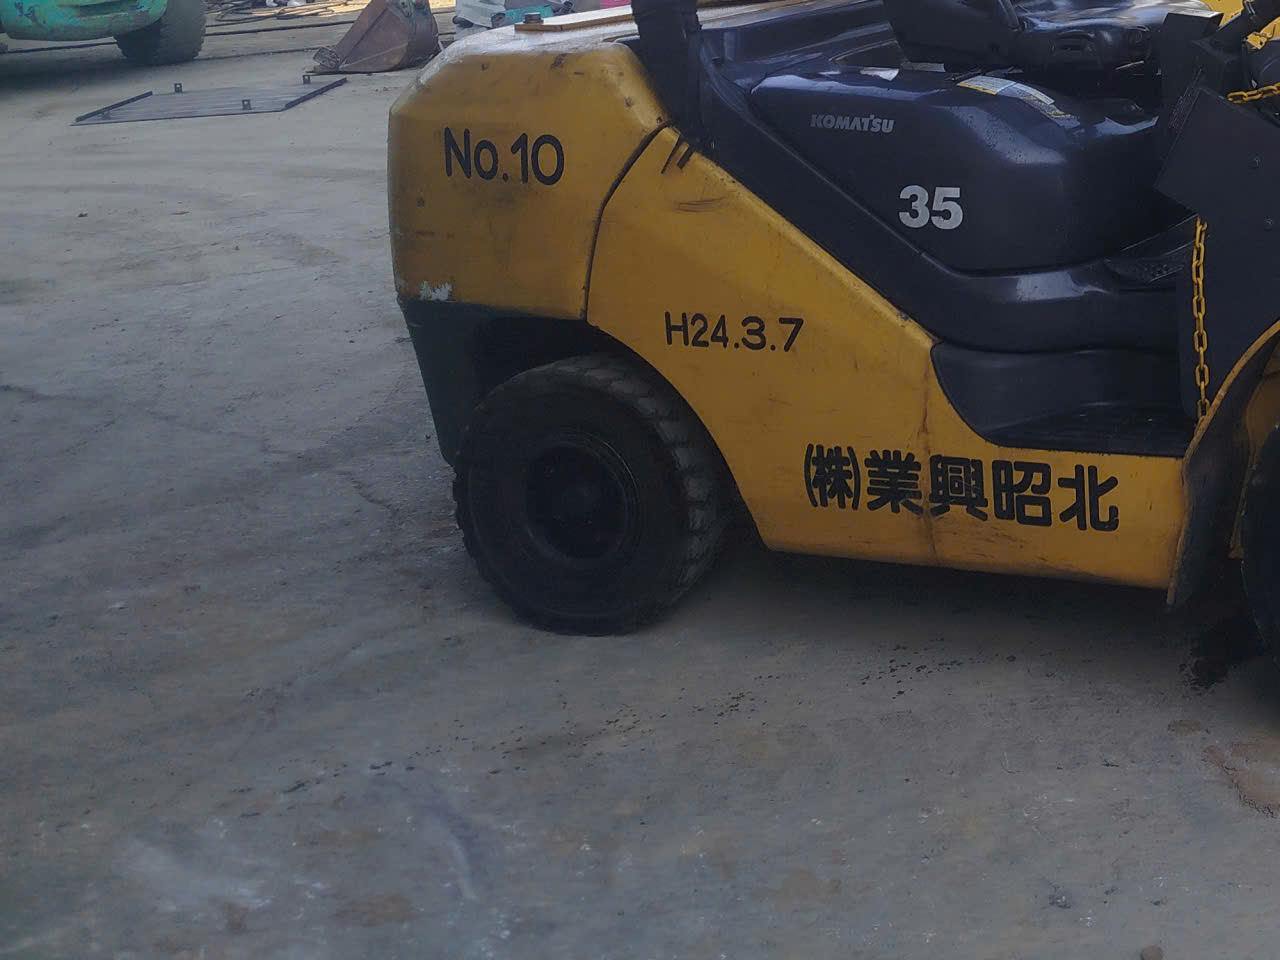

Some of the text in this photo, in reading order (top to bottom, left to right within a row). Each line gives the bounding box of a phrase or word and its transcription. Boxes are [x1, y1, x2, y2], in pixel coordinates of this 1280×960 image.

[809, 113, 895, 134] KOMATSU
[443, 126, 566, 186] No.10
[897, 184, 965, 231] 35
[664, 311, 804, 353] H24.3.7
